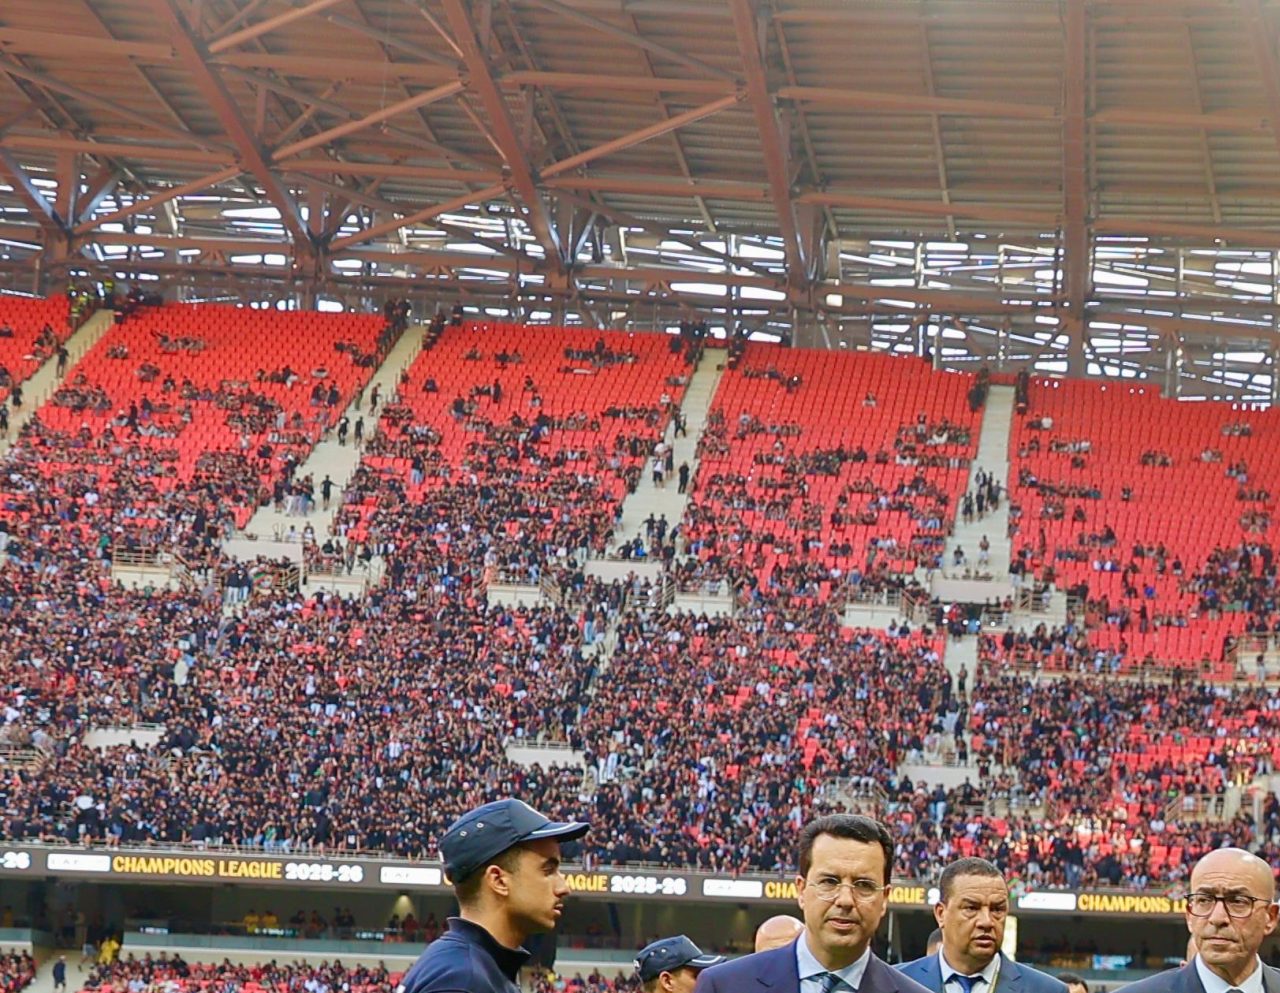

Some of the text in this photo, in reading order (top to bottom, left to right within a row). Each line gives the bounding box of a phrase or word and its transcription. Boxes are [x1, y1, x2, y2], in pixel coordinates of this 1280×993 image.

[113, 856, 363, 882] CHAMPIONS LEAGUE 2025-26
[610, 875, 687, 895] 2025-26
[1078, 893, 1171, 914] CHAMPIONS
